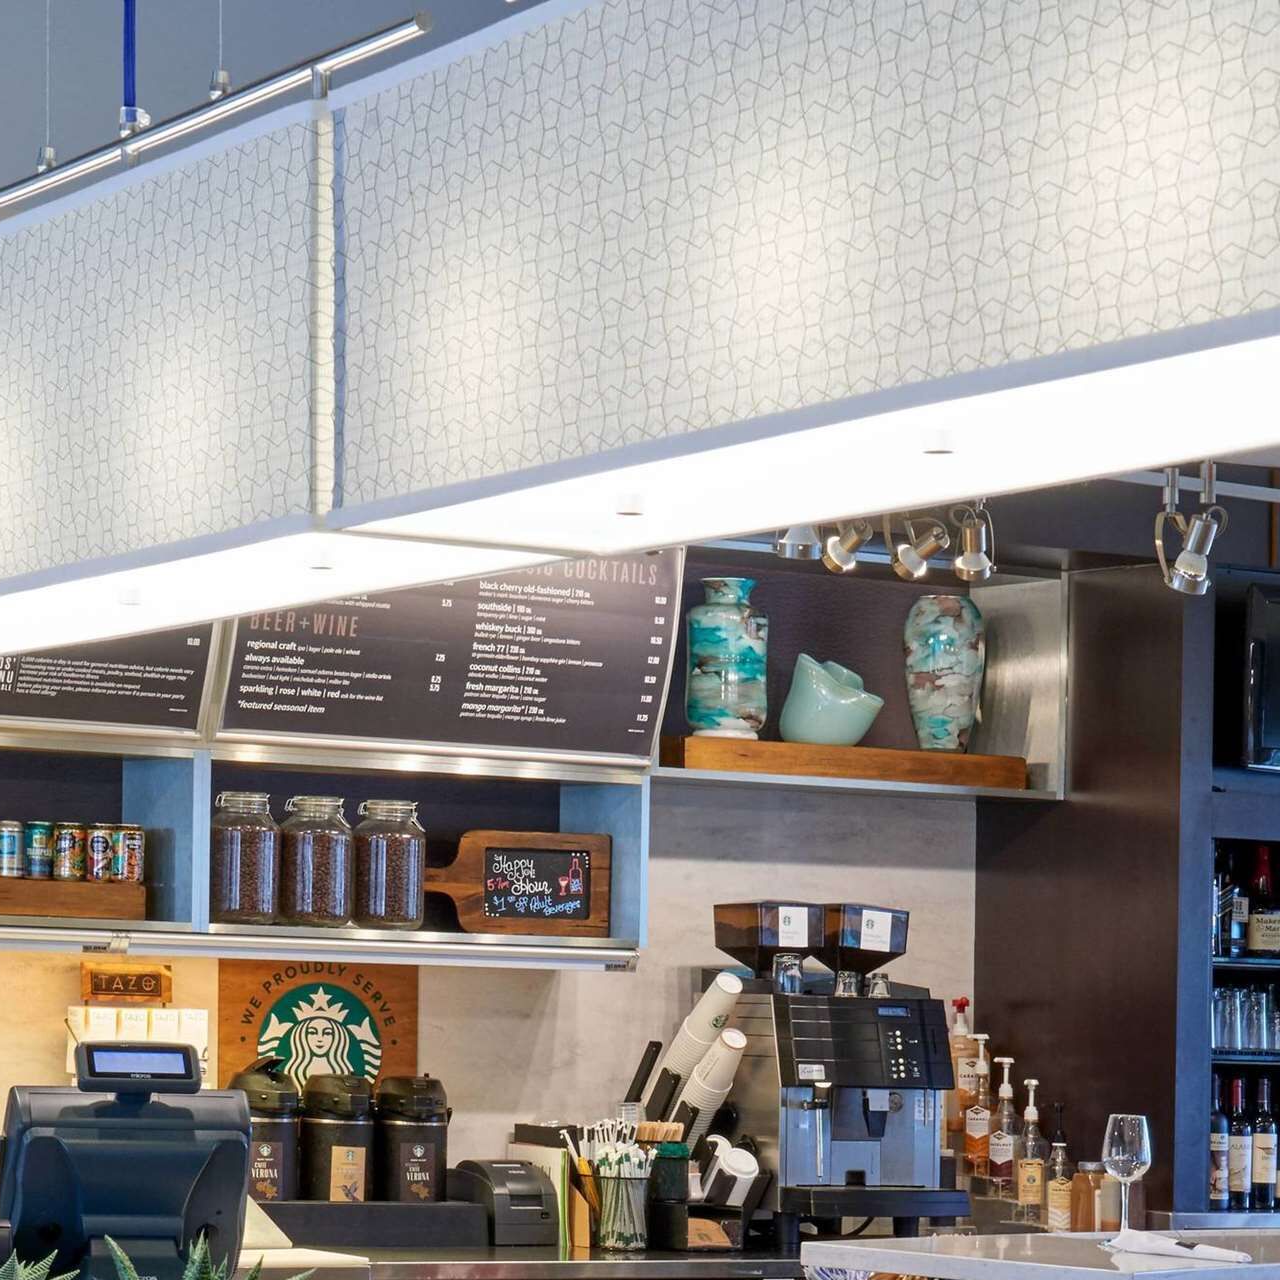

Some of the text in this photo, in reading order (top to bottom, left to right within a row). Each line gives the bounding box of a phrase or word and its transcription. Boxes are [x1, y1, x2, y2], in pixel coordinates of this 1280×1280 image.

[565, 559, 658, 585] COCKTAILS
[478, 581, 570, 596] black cherry old-fashioned
[477, 602, 512, 612] southside
[474, 622, 522, 633] whiskey buck
[247, 638, 296, 650] regional craft
[472, 641, 504, 652] french 77
[244, 653, 304, 665] always available
[469, 663, 521, 673] coconut collins
[239, 683, 340, 698] sparkling rose white red
[465, 681, 518, 694] fresh margarita
[273, 702, 307, 712] seasonal
[307, 704, 325, 713] item
[461, 702, 486, 712] mango
[493, 854, 535, 880] Happy
[511, 878, 552, 895] Hour
[98, 976, 156, 991] TAZO
[241, 961, 396, 1027] WE PROUDLY SERVE
[251, 1168, 278, 1179] VERONA
[406, 1171, 430, 1181] VERONA
